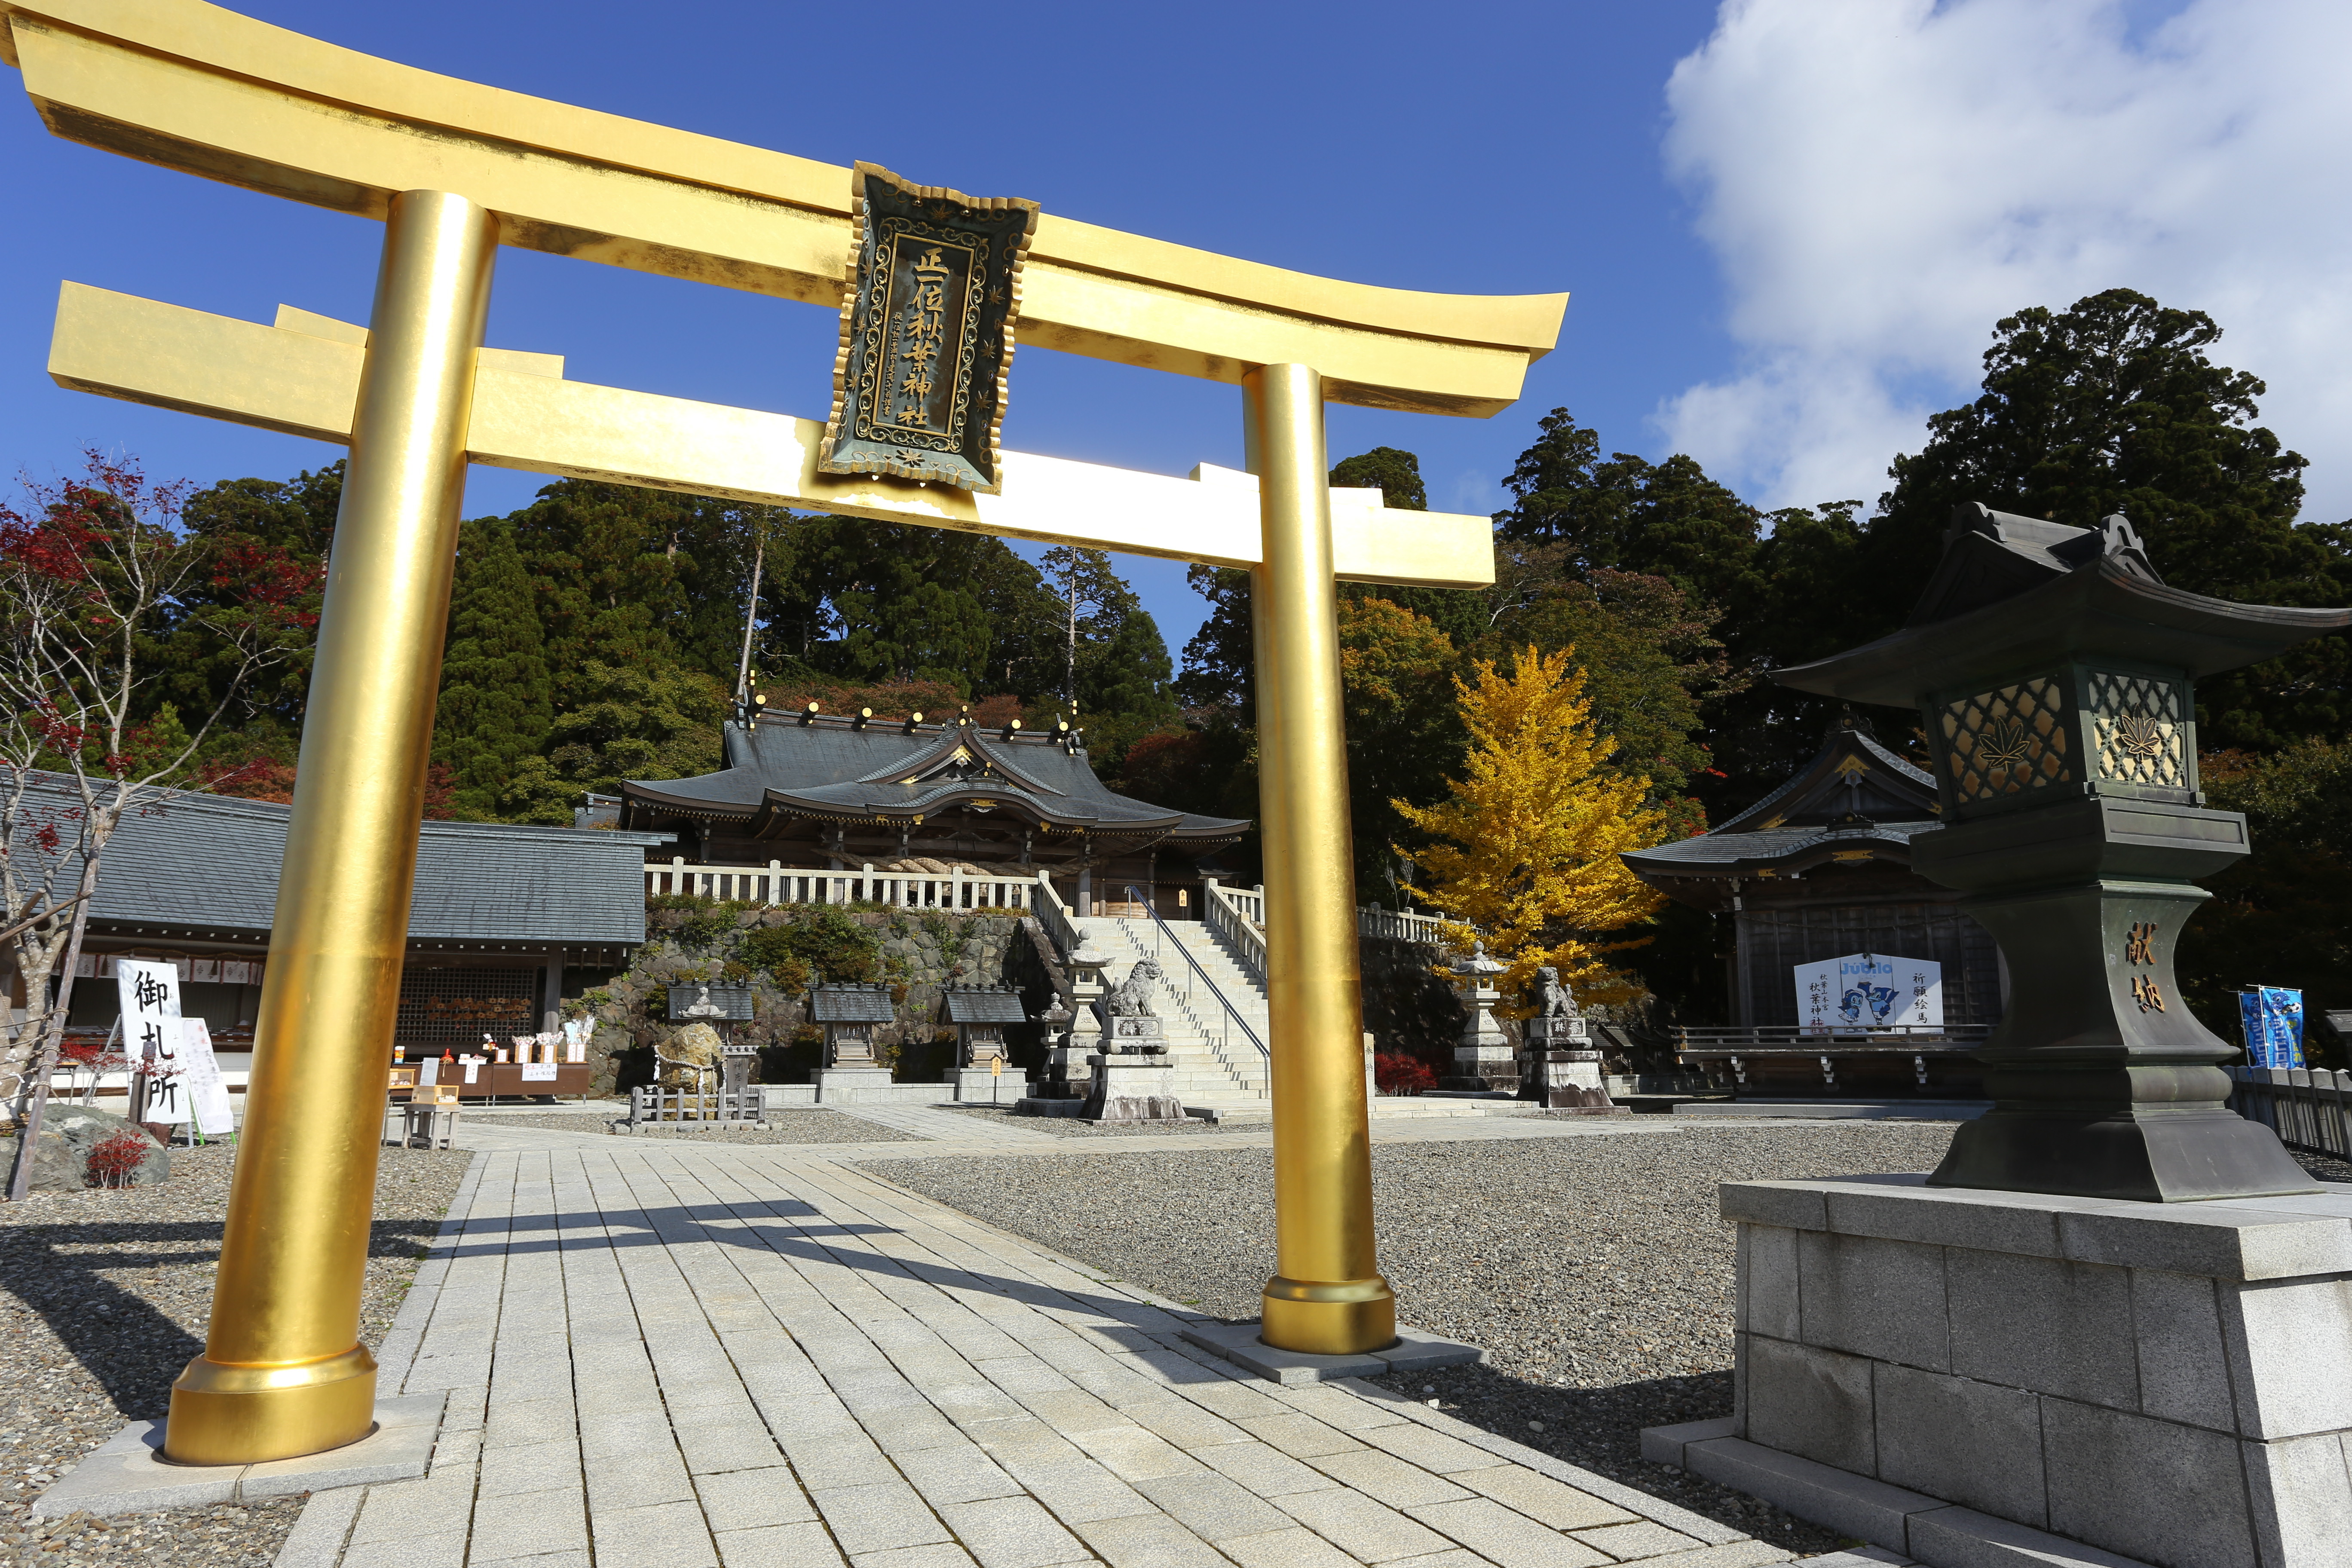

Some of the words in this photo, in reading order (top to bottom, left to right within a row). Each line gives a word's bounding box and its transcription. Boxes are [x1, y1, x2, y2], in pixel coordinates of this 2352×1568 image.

[897, 247, 949, 426] 正一位秋葉神社
[1180, 891, 1185, 905] 本殿
[1809, 982, 1822, 1026] 秋葉神社
[1819, 974, 1829, 1011] 秋葉山本宮
[1912, 973, 1928, 1023] 祈願絵馬
[134, 970, 178, 1114] 御札所
